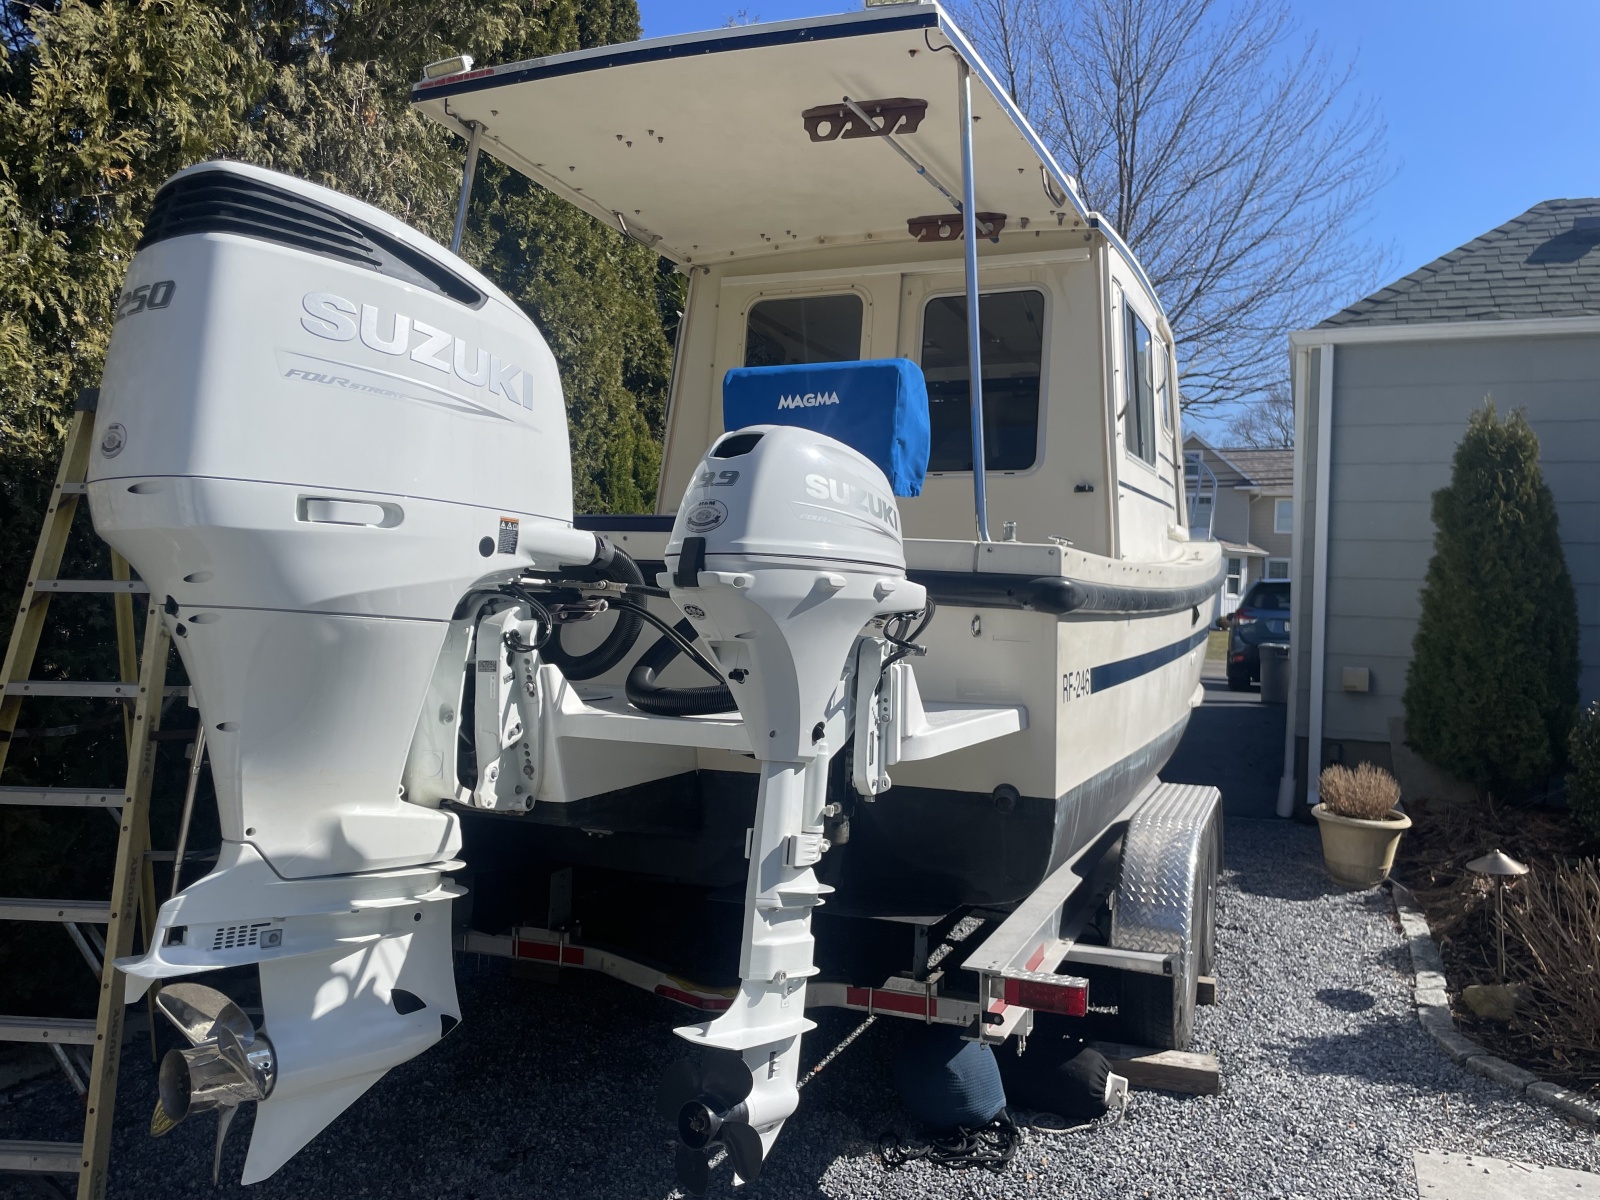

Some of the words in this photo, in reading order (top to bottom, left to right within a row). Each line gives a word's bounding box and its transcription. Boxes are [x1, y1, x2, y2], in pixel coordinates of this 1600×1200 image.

[116, 280, 176, 322] 250
[300, 292, 534, 411] SUZUKI
[284, 368, 351, 388] FOUR
[777, 391, 840, 410] MAGMA
[805, 474, 899, 532] SUZUKI
[1062, 668, 1090, 704] RF-246
[108, 1008, 120, 1062] HUSKY
